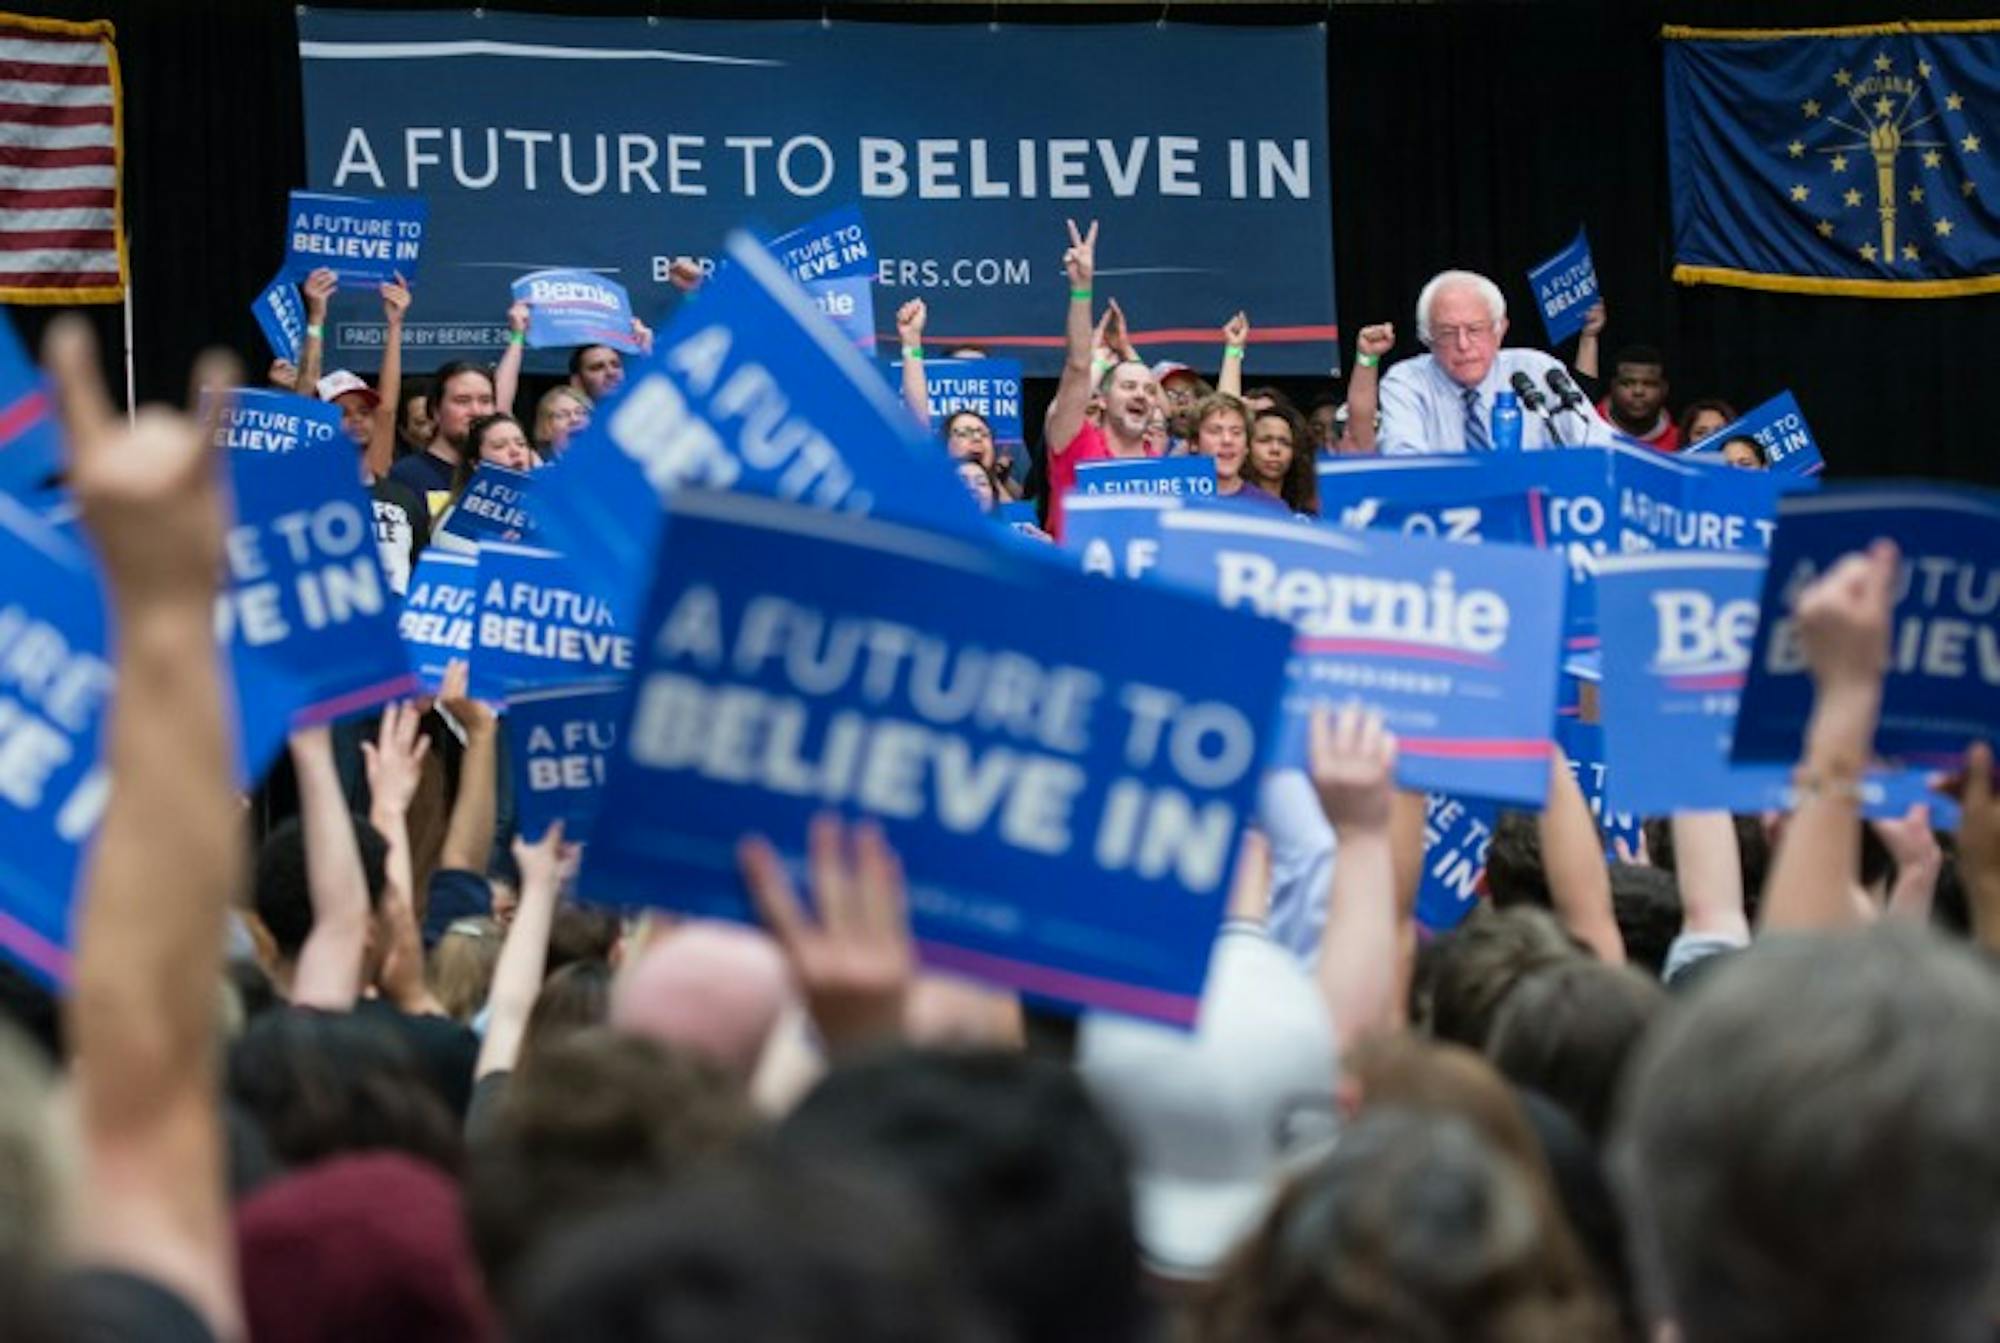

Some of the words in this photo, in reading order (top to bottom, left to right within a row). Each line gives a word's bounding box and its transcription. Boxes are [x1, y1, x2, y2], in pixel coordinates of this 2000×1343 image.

[333, 127, 386, 188] A
[404, 127, 707, 195] FUTURE
[725, 135, 834, 196] TO
[859, 136, 1200, 198] BELIEVE
[1229, 138, 1311, 198] IN
[296, 213, 309, 229] A
[313, 214, 393, 238] FUTURE
[397, 221, 421, 238] TO
[834, 225, 861, 246] TO
[292, 233, 392, 259] BELIEVE
[396, 242, 419, 260] IN
[842, 241, 867, 264] IN
[530, 279, 621, 309] Bernie
[344, 328, 380, 345] PAID
[417, 328, 437, 345] BY
[438, 328, 490, 345] BERNIE
[992, 379, 1018, 396] TO
[996, 399, 1018, 417] IN
[304, 420, 334, 441] TO
[1773, 413, 1799, 434] TO
[1784, 430, 1809, 453] IN
[473, 479, 488, 495] A
[1105, 477, 1182, 495] FUTURE
[1187, 477, 1213, 495] TO
[274, 501, 364, 564] TO
[1637, 493, 1745, 550] FUTURE
[298, 555, 383, 629] IN
[408, 582, 430, 607] A
[484, 578, 505, 609] A
[1215, 550, 1511, 653] Bernie
[479, 612, 634, 669] BELIEVE
[656, 585, 722, 667] A
[733, 596, 1102, 753] FUTURE
[1121, 683, 1255, 788] TO
[527, 725, 555, 753] A
[629, 671, 1085, 854] BELIEVE
[1096, 778, 1235, 892] IN
[1433, 850, 1484, 900] IN
